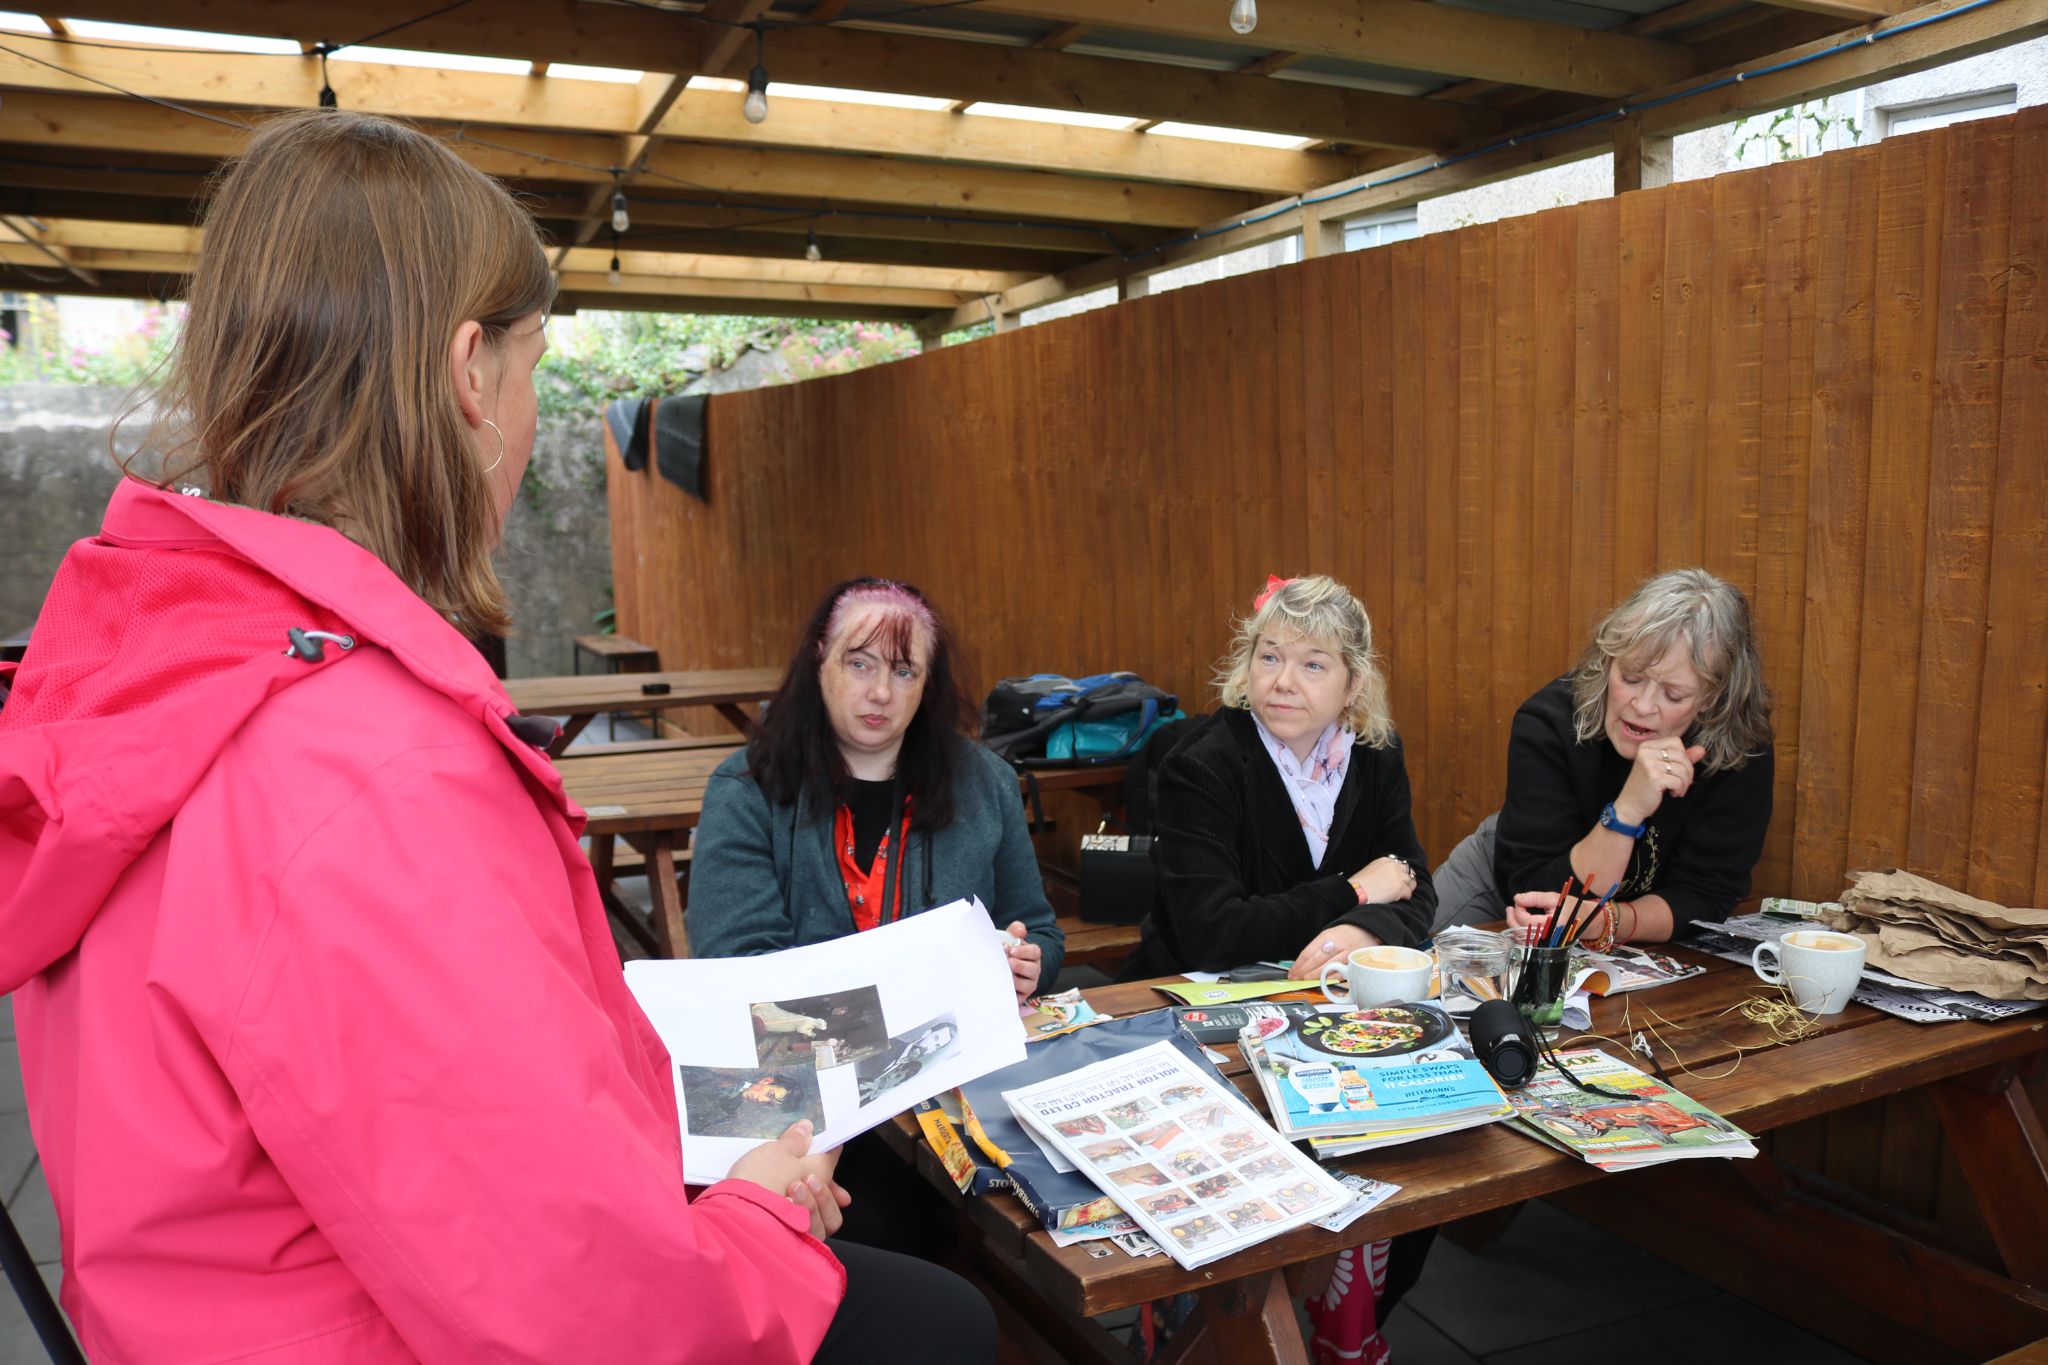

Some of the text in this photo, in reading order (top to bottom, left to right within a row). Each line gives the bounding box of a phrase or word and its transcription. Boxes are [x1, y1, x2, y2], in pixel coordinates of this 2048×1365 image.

[1379, 1063, 1460, 1077] SIMPLE SWAPS
[1430, 1069, 1463, 1077] THAN
[1398, 1074, 1466, 1087] CALORIES
[1040, 1066, 1180, 1116] HOLTON TRACTOR CO LTD
